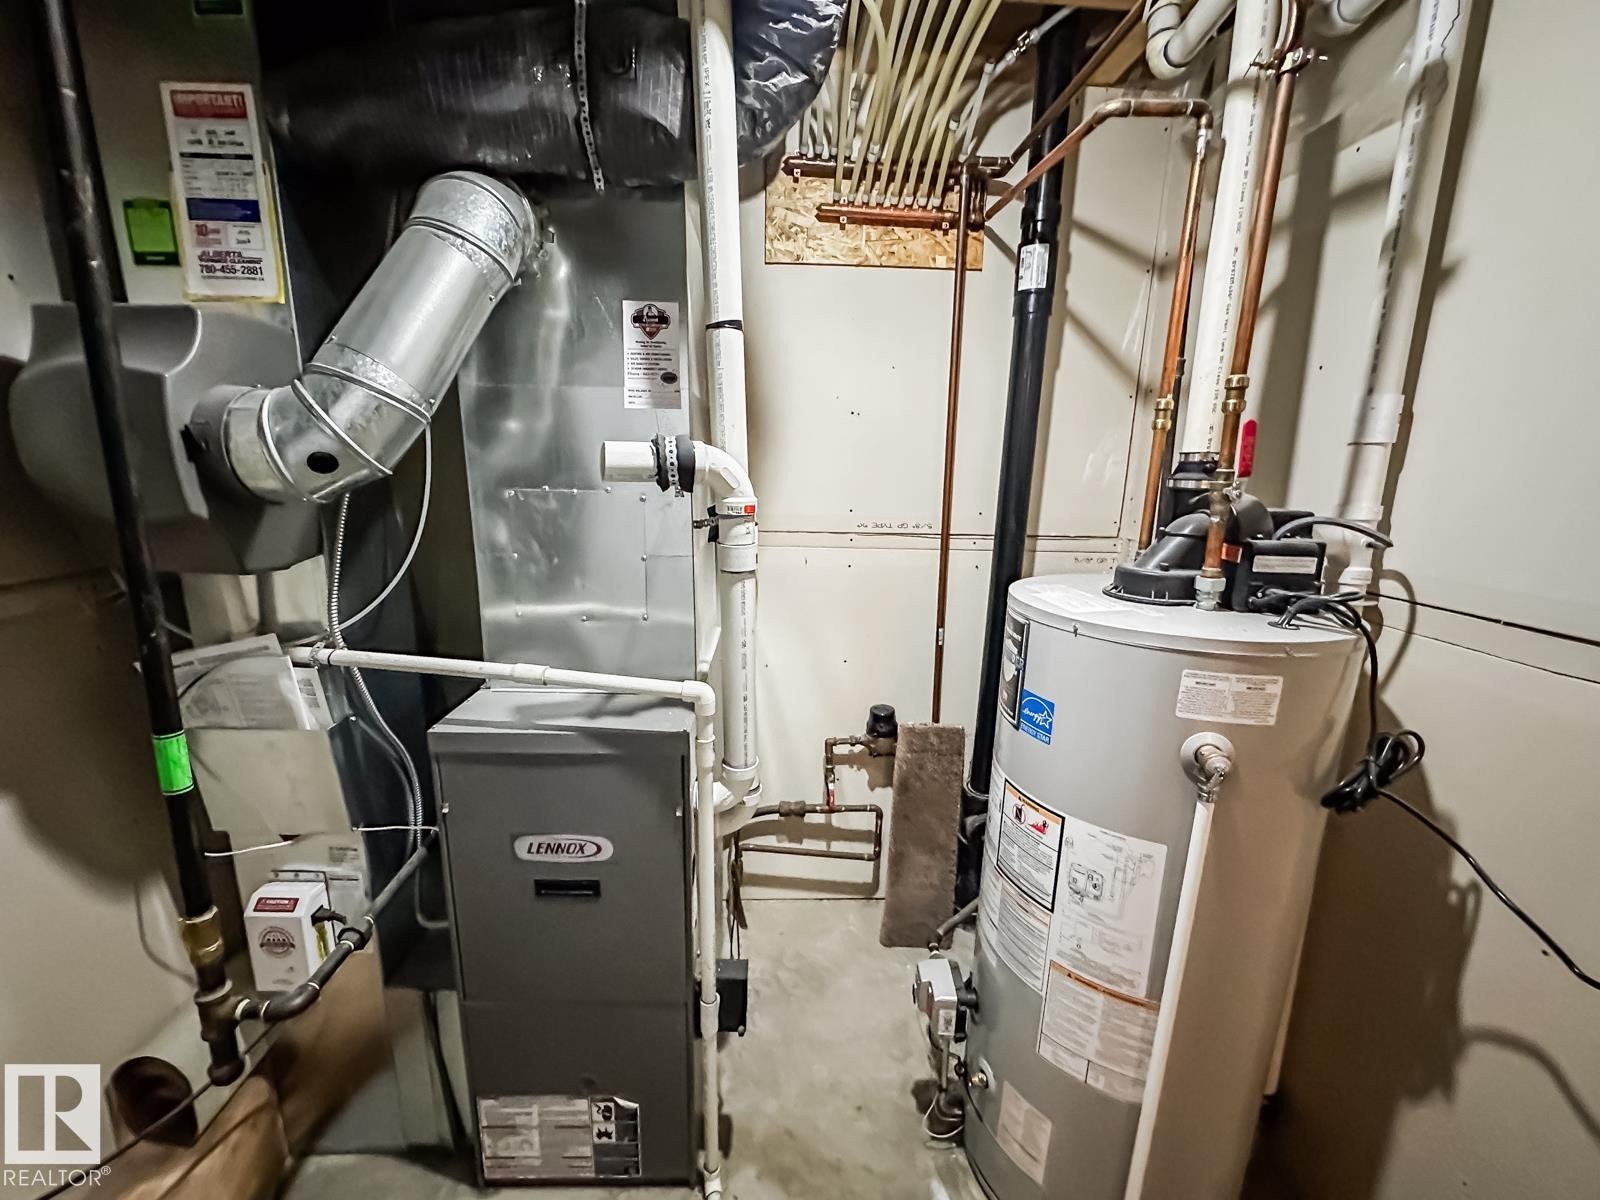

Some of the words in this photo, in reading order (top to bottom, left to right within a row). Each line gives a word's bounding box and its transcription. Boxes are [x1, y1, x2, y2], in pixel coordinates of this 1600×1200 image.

[199, 263, 264, 276] 780-455-2881
[871, 521, 892, 529] TYPE
[526, 842, 588, 855] LENNOX
